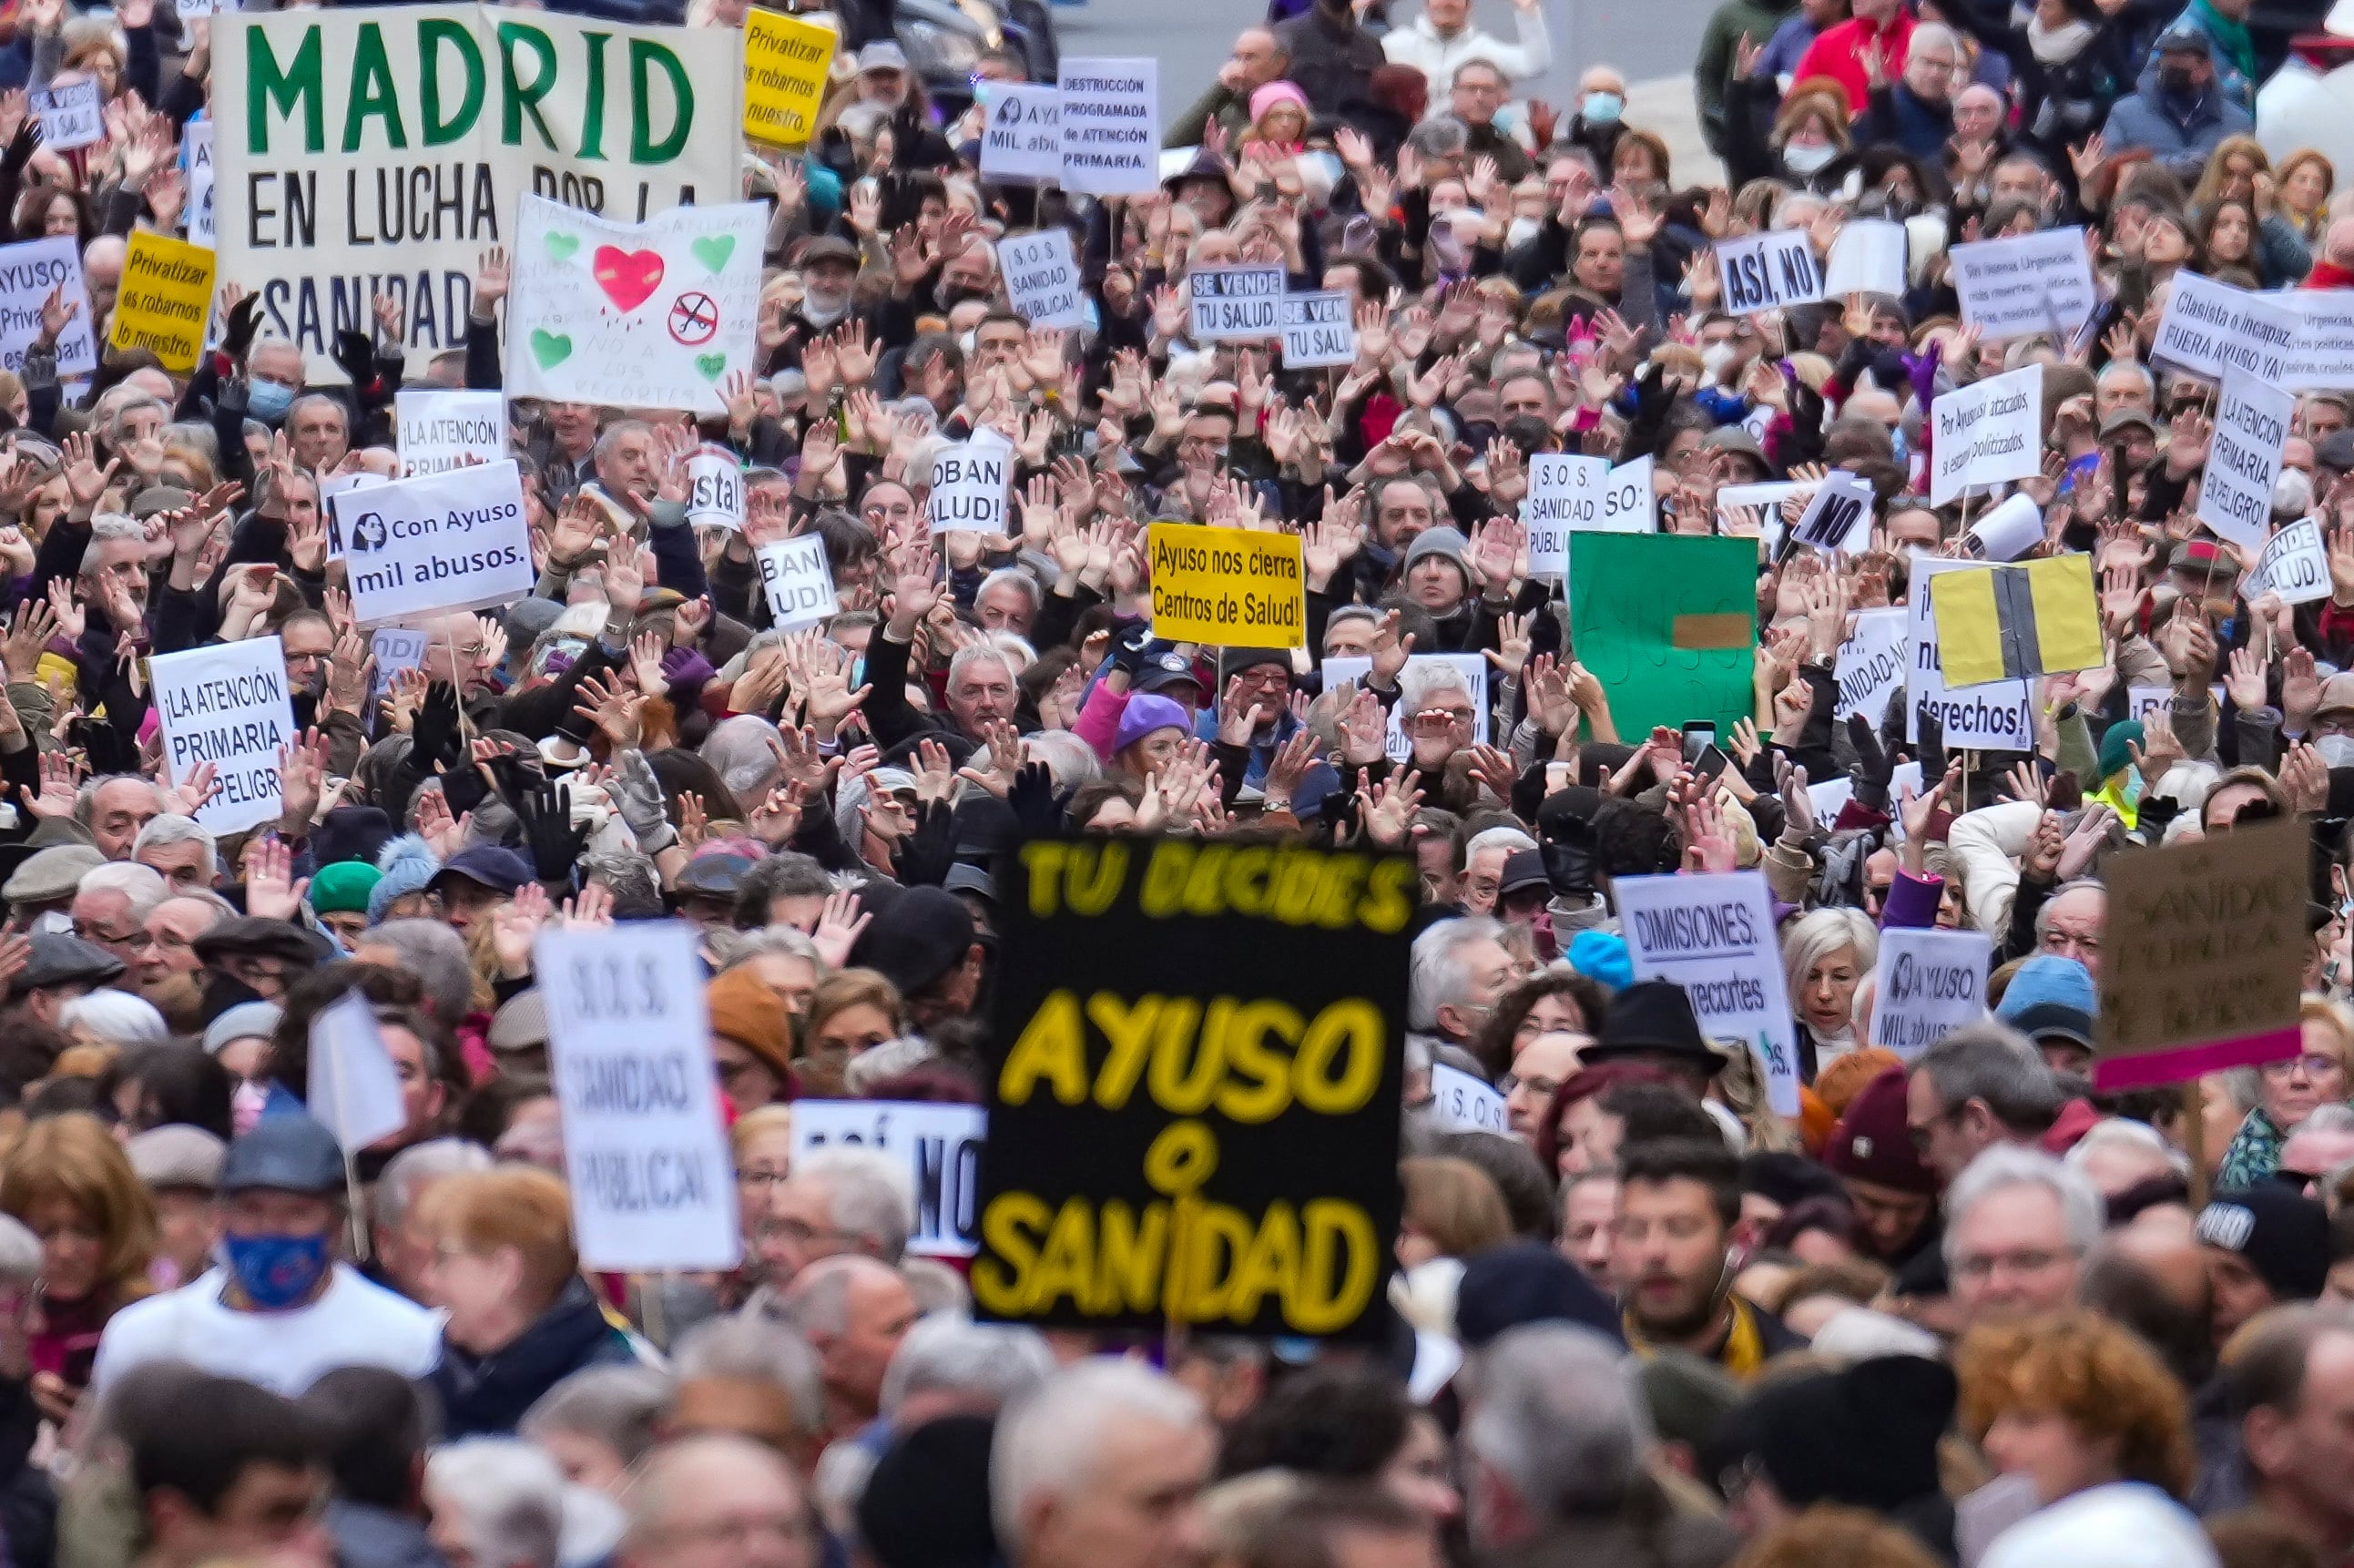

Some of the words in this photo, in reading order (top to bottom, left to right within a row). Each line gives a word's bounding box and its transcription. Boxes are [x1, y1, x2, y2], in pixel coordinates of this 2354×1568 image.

[748, 25, 824, 64] Privatizar
[246, 18, 696, 165] MADRID
[1064, 78, 1144, 93] DESTRUCCIÓN
[1064, 102, 1147, 118] PROGRAMADA
[989, 130, 1021, 150] MIL
[1081, 127, 1147, 143] ATENCIÓN
[248, 170, 317, 248] EN
[346, 162, 499, 245] LUCHA
[129, 248, 209, 286] Privatizar
[1012, 266, 1067, 296] SANIDAD
[1192, 274, 1216, 297] SE
[1220, 272, 1279, 297] VENDE
[1778, 246, 1813, 300] NO
[140, 290, 201, 323] robarnos
[1197, 301, 1218, 330] TU
[2176, 290, 2229, 328] Clasista
[2229, 314, 2239, 331] o
[1288, 331, 1309, 358] TU
[2164, 323, 2212, 361] FUERA
[2211, 340, 2260, 373] AYUSO
[403, 419, 426, 453] ¡LA
[430, 414, 497, 445] ATENCIÓN
[1941, 412, 1954, 437] Por
[2235, 401, 2283, 450] ATENCIÓN
[2214, 432, 2271, 494] PRIMARIA,
[392, 519, 438, 539] Con
[445, 502, 517, 533] Ayuso
[1532, 497, 1595, 522] SANIDAD
[1804, 493, 1862, 548] NO
[355, 561, 404, 594] mil
[413, 545, 525, 584] abusos.
[759, 546, 820, 583] BAN
[1152, 538, 1207, 577] ¡Ayuso
[1212, 549, 1243, 575] nos
[1248, 546, 1297, 579] cierra
[770, 583, 829, 620] UD!
[1153, 585, 1212, 622] Centros
[1217, 592, 1238, 625] de
[1244, 592, 1300, 627] Salud!
[164, 688, 195, 728] ¡LA
[196, 666, 281, 716] ATENCIÓN
[172, 719, 290, 766] PRIMARIA,
[1020, 841, 1129, 918] TU
[1634, 901, 1759, 952] DIMISIONES:
[1689, 969, 1765, 1017] recortes
[1879, 1013, 1907, 1046] MIL
[998, 988, 1387, 1125] AYUSO
[972, 1190, 1381, 1335] SANIDAD
